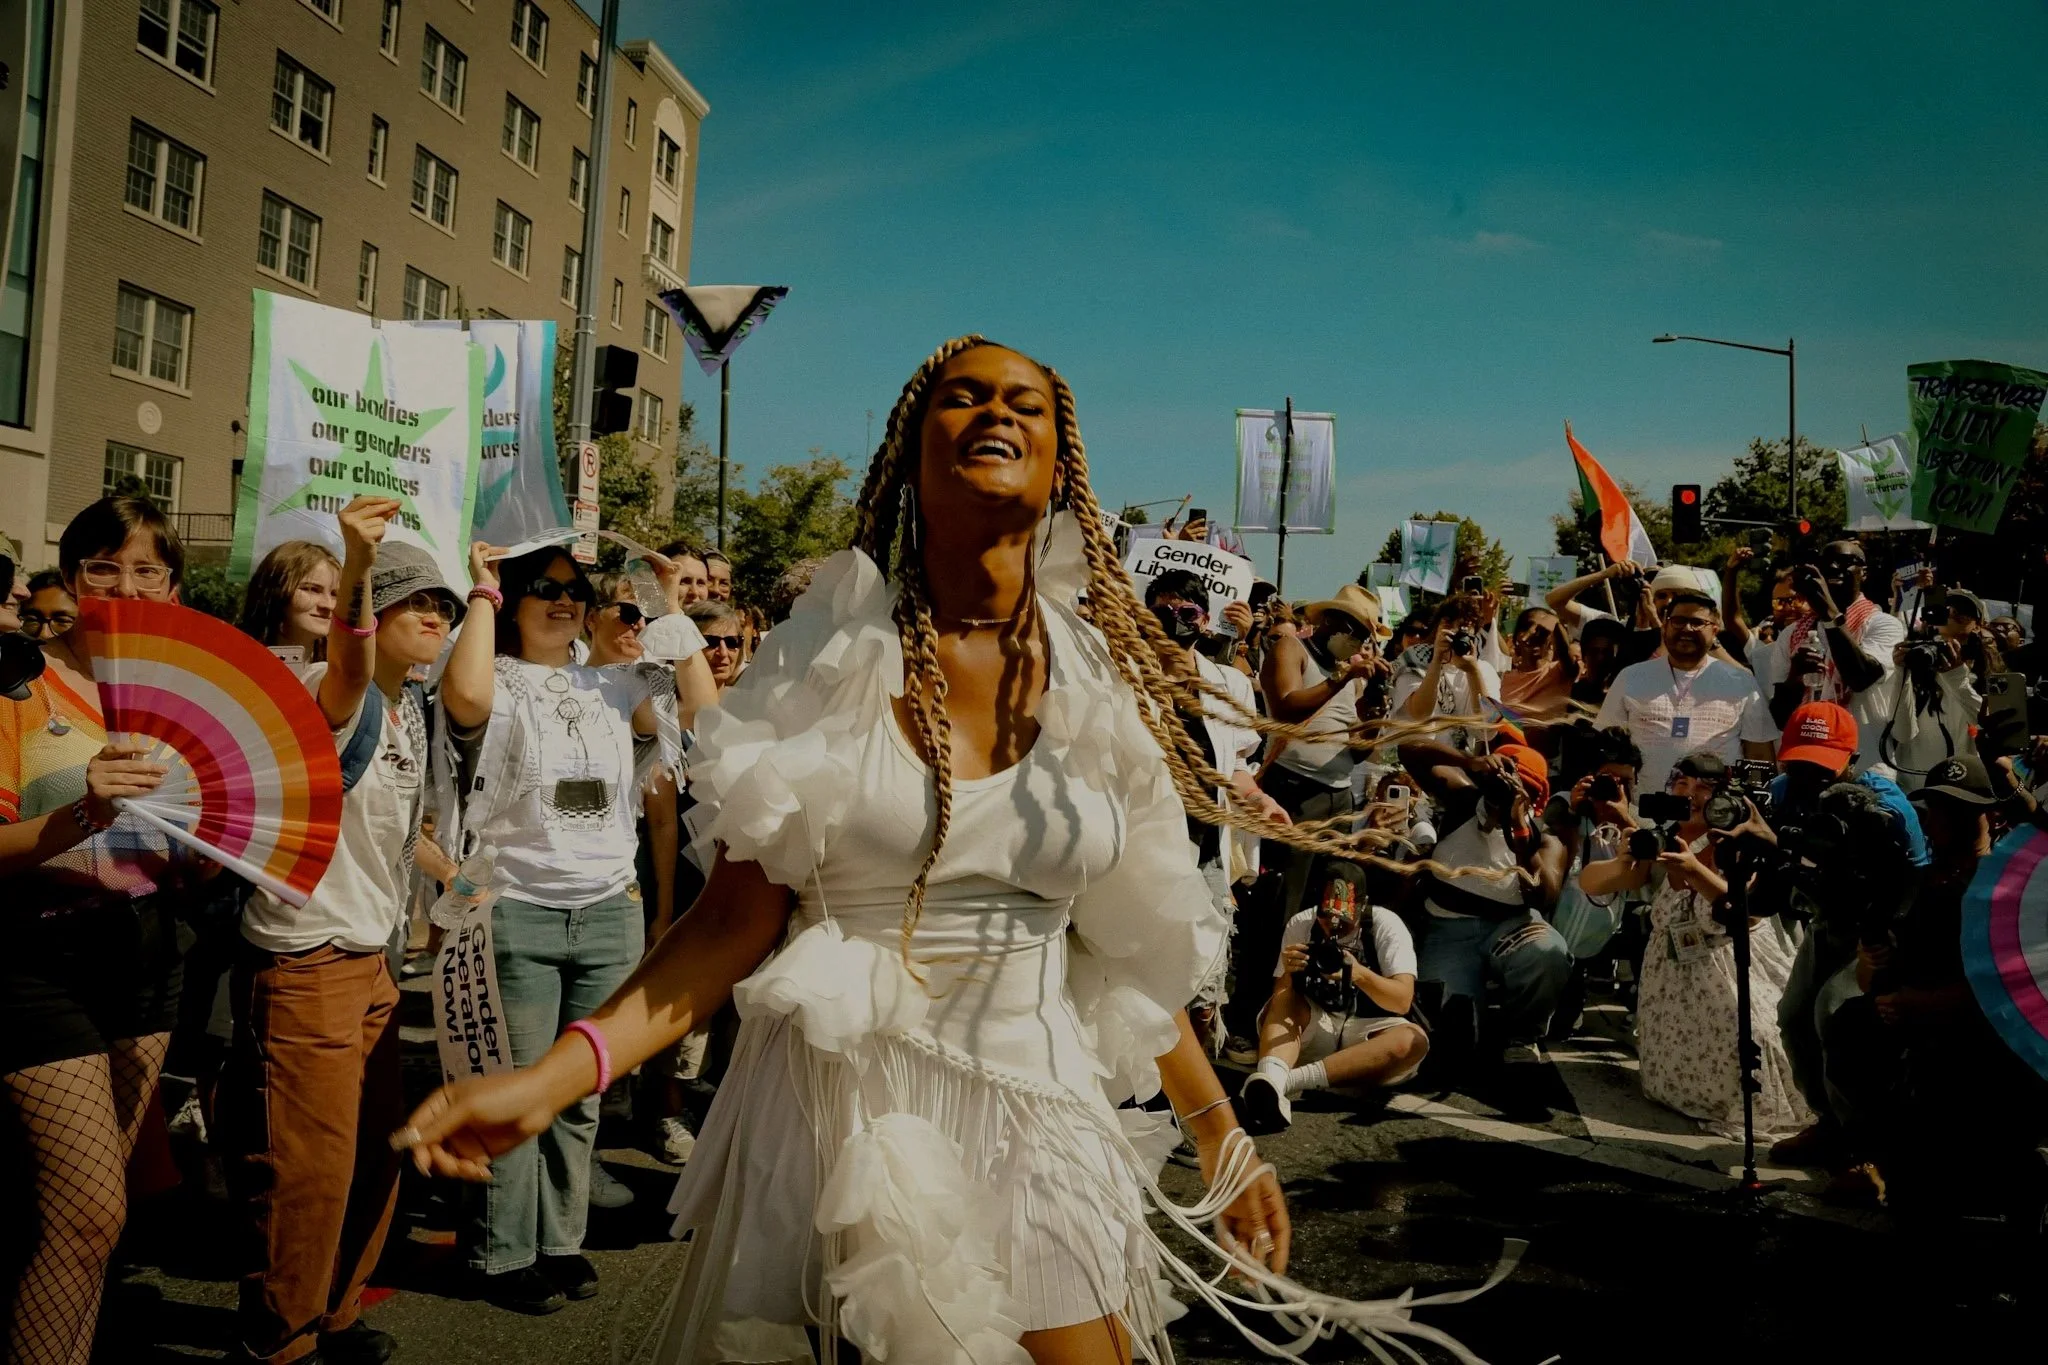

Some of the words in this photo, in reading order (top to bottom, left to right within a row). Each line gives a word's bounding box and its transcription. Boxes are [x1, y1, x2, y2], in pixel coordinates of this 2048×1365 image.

[312, 387, 348, 409] our
[356, 390, 419, 427] bodies
[482, 408, 520, 427] ders
[312, 422, 349, 444] our
[355, 430, 431, 465] genders
[481, 443, 519, 459] ures
[309, 458, 347, 480] our
[352, 460, 419, 497] choices
[305, 494, 344, 516] our
[1101, 513, 1116, 528] EER
[1134, 559, 1238, 600] Libtion
[1154, 545, 1232, 576] Gender
[443, 947, 463, 1043] Now!
[457, 908, 485, 1078] iberatio
[472, 922, 501, 1065] Gender
